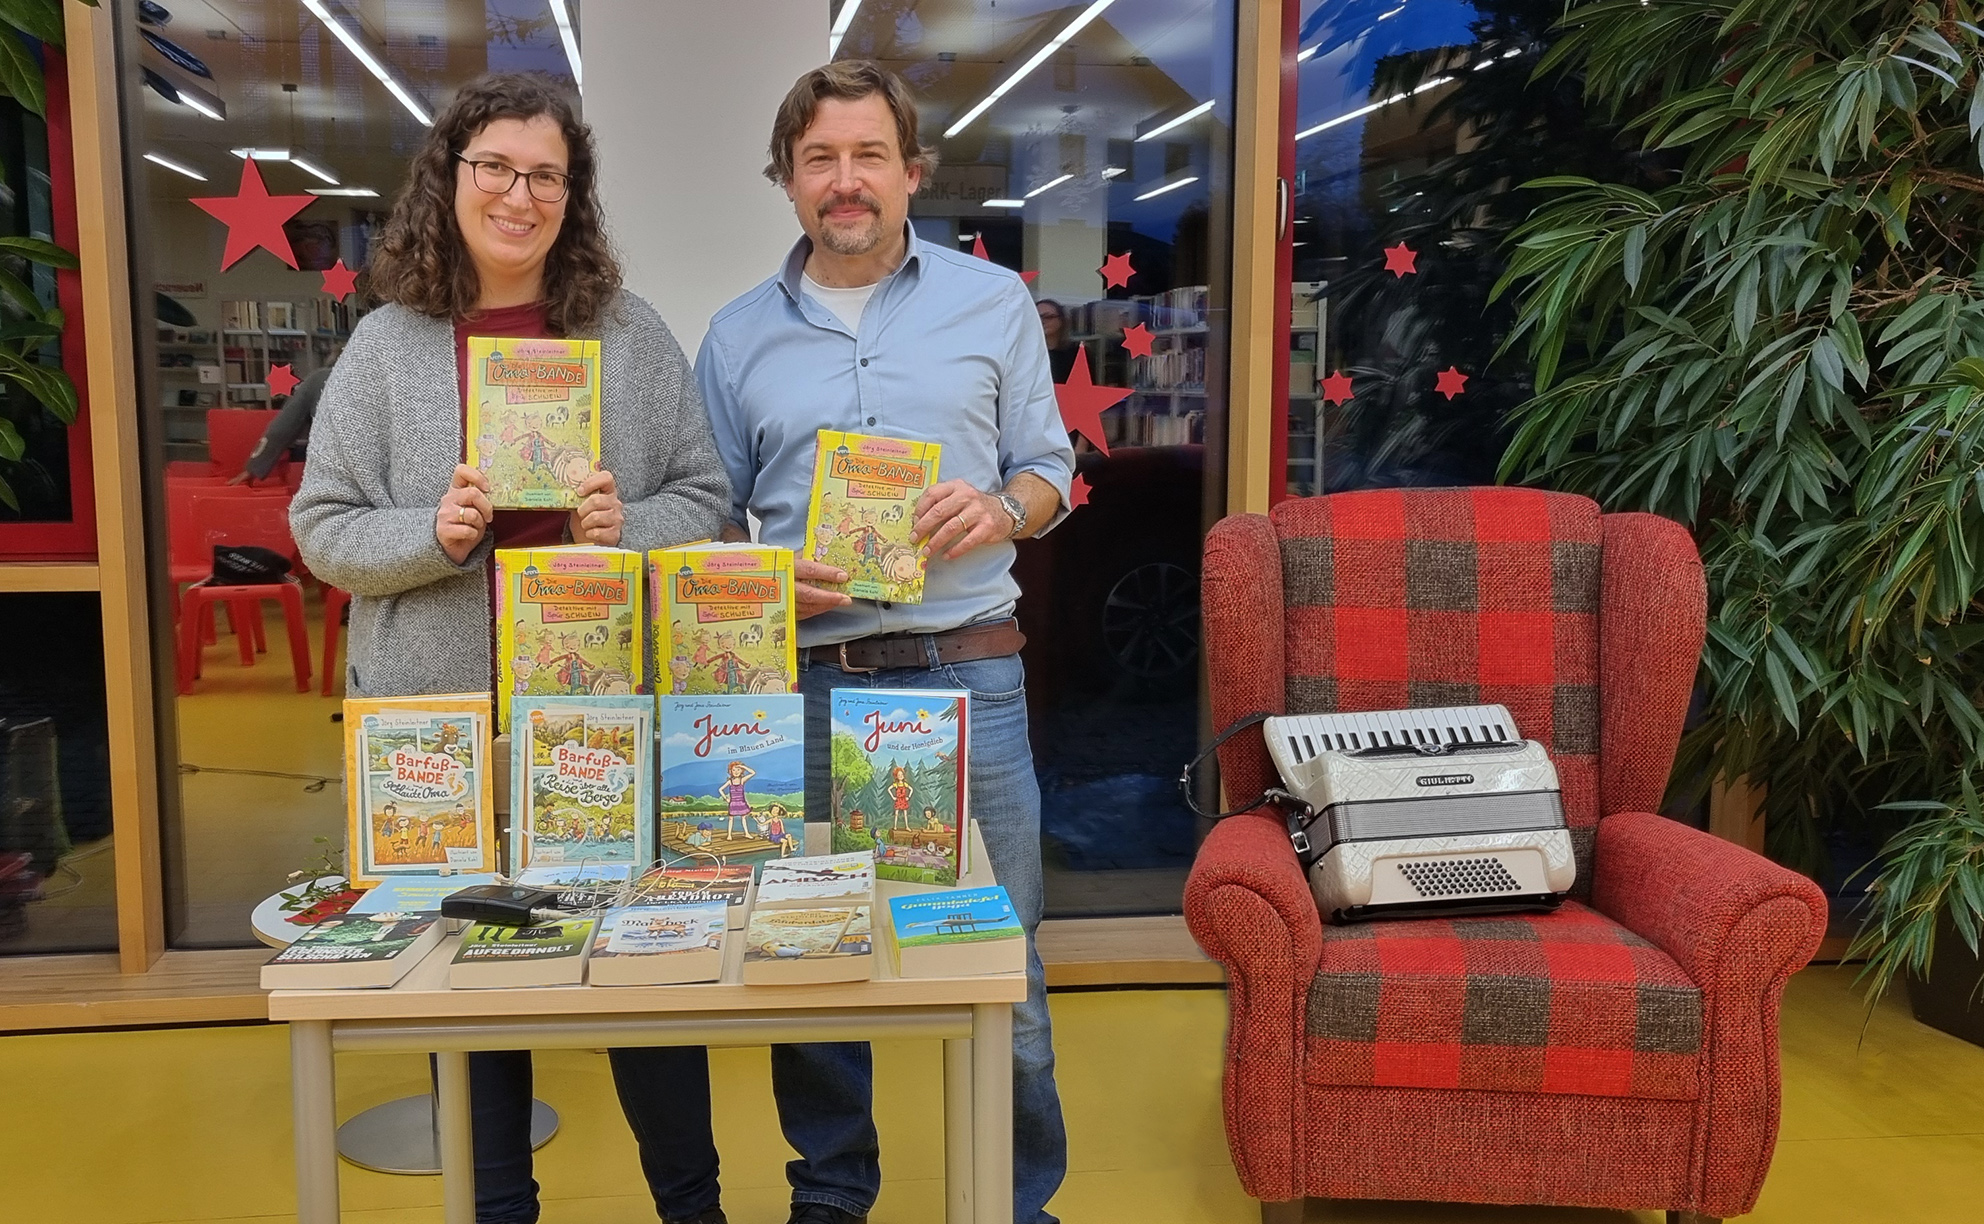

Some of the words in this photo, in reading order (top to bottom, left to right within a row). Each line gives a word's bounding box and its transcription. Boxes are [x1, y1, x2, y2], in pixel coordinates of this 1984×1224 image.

[493, 363, 584, 384] Oma-BANDE
[837, 457, 921, 485] Oma-BANDE
[867, 489, 899, 498] SCHWEIN
[552, 561, 567, 570] Jörg
[706, 561, 721, 570] Jörg
[528, 578, 624, 601] Oma-BANDE
[682, 577, 777, 599] Oma-BANDE
[720, 611, 756, 619] SCHWEIN
[586, 713, 599, 723] Jörg
[693, 712, 770, 757] Juni
[864, 709, 932, 752] Juni
[727, 747, 738, 755] im
[739, 742, 765, 753] Blauen
[765, 735, 784, 747] Land
[887, 743, 899, 751] und
[900, 742, 911, 751] der
[911, 737, 944, 750] Honigdieb
[395, 752, 459, 772] Barfuß-
[558, 748, 620, 768] Barfuß-
[397, 767, 445, 785] BANDE
[559, 762, 605, 781] BANDE
[422, 786, 450, 799] Oma
[543, 774, 580, 795] Reise
[597, 783, 612, 793] alle
[580, 789, 620, 807] Berge
[463, 944, 574, 956] AUFGEDIRNDLT
